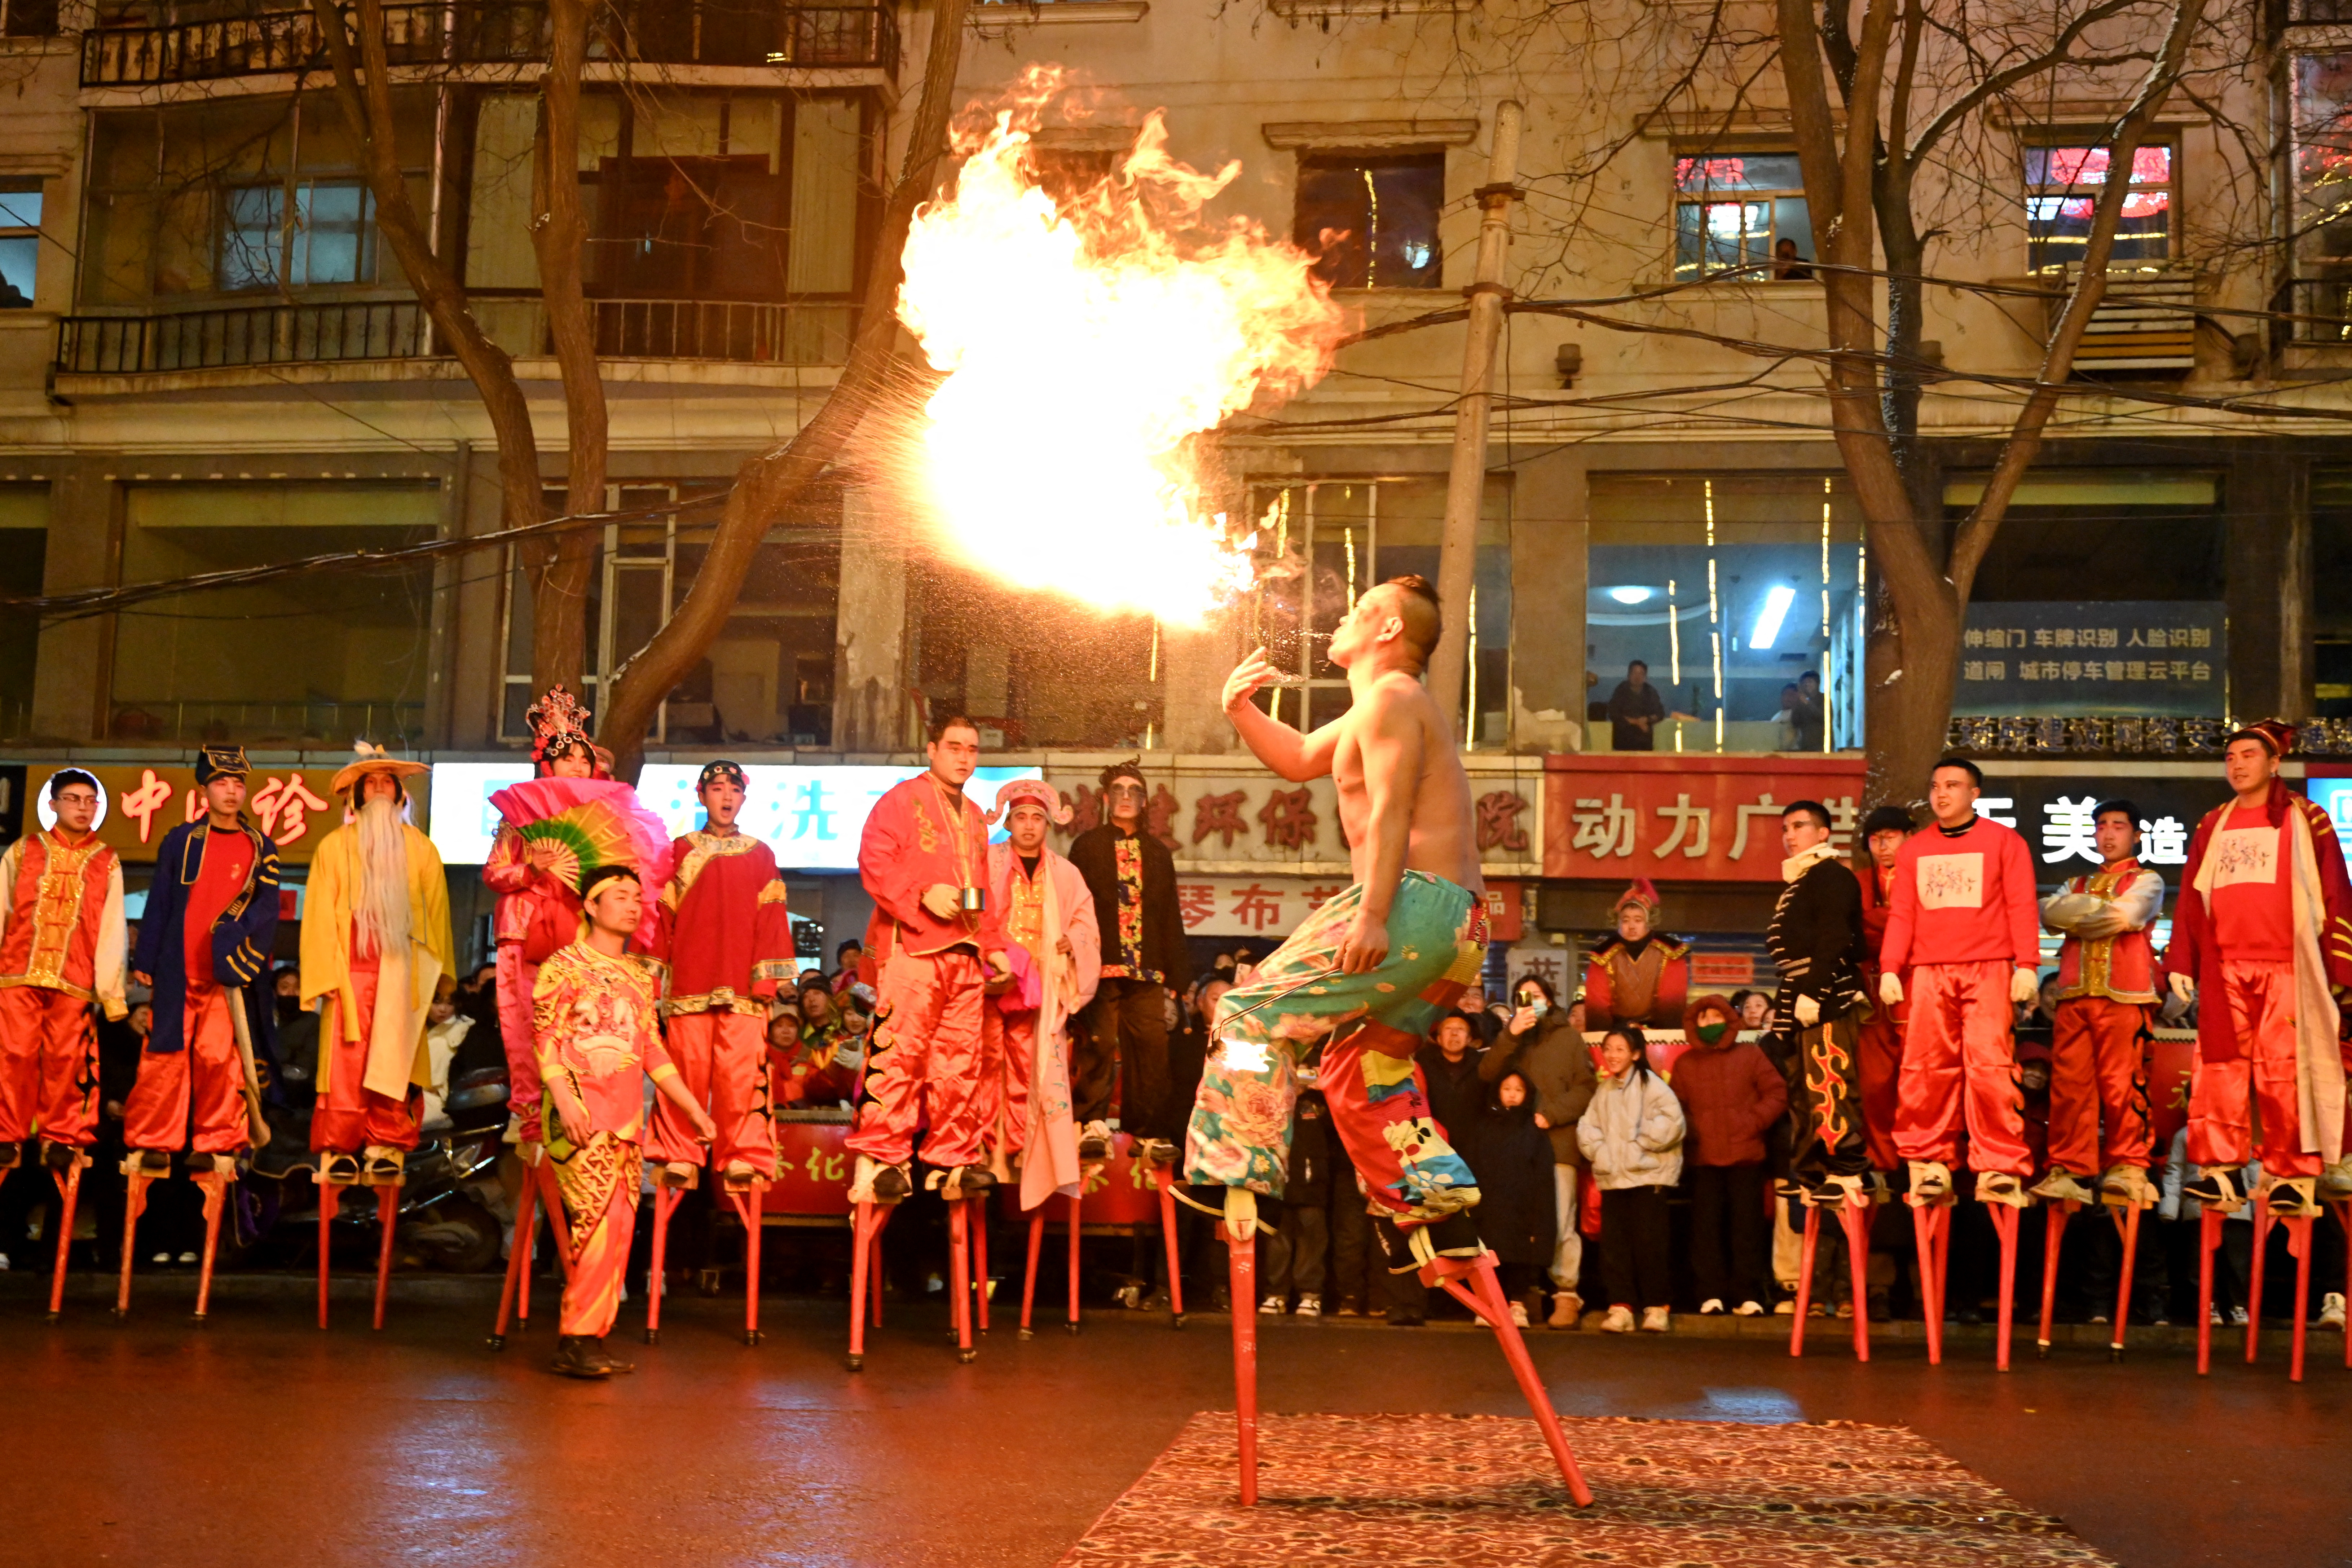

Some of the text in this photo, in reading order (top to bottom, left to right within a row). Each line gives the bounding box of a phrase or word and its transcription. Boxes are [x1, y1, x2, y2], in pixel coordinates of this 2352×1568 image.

[2033, 628, 2118, 648] 车牌识别
[2126, 628, 2211, 648] 人脸识别
[2019, 661, 2211, 681] 城市停车管理云平台
